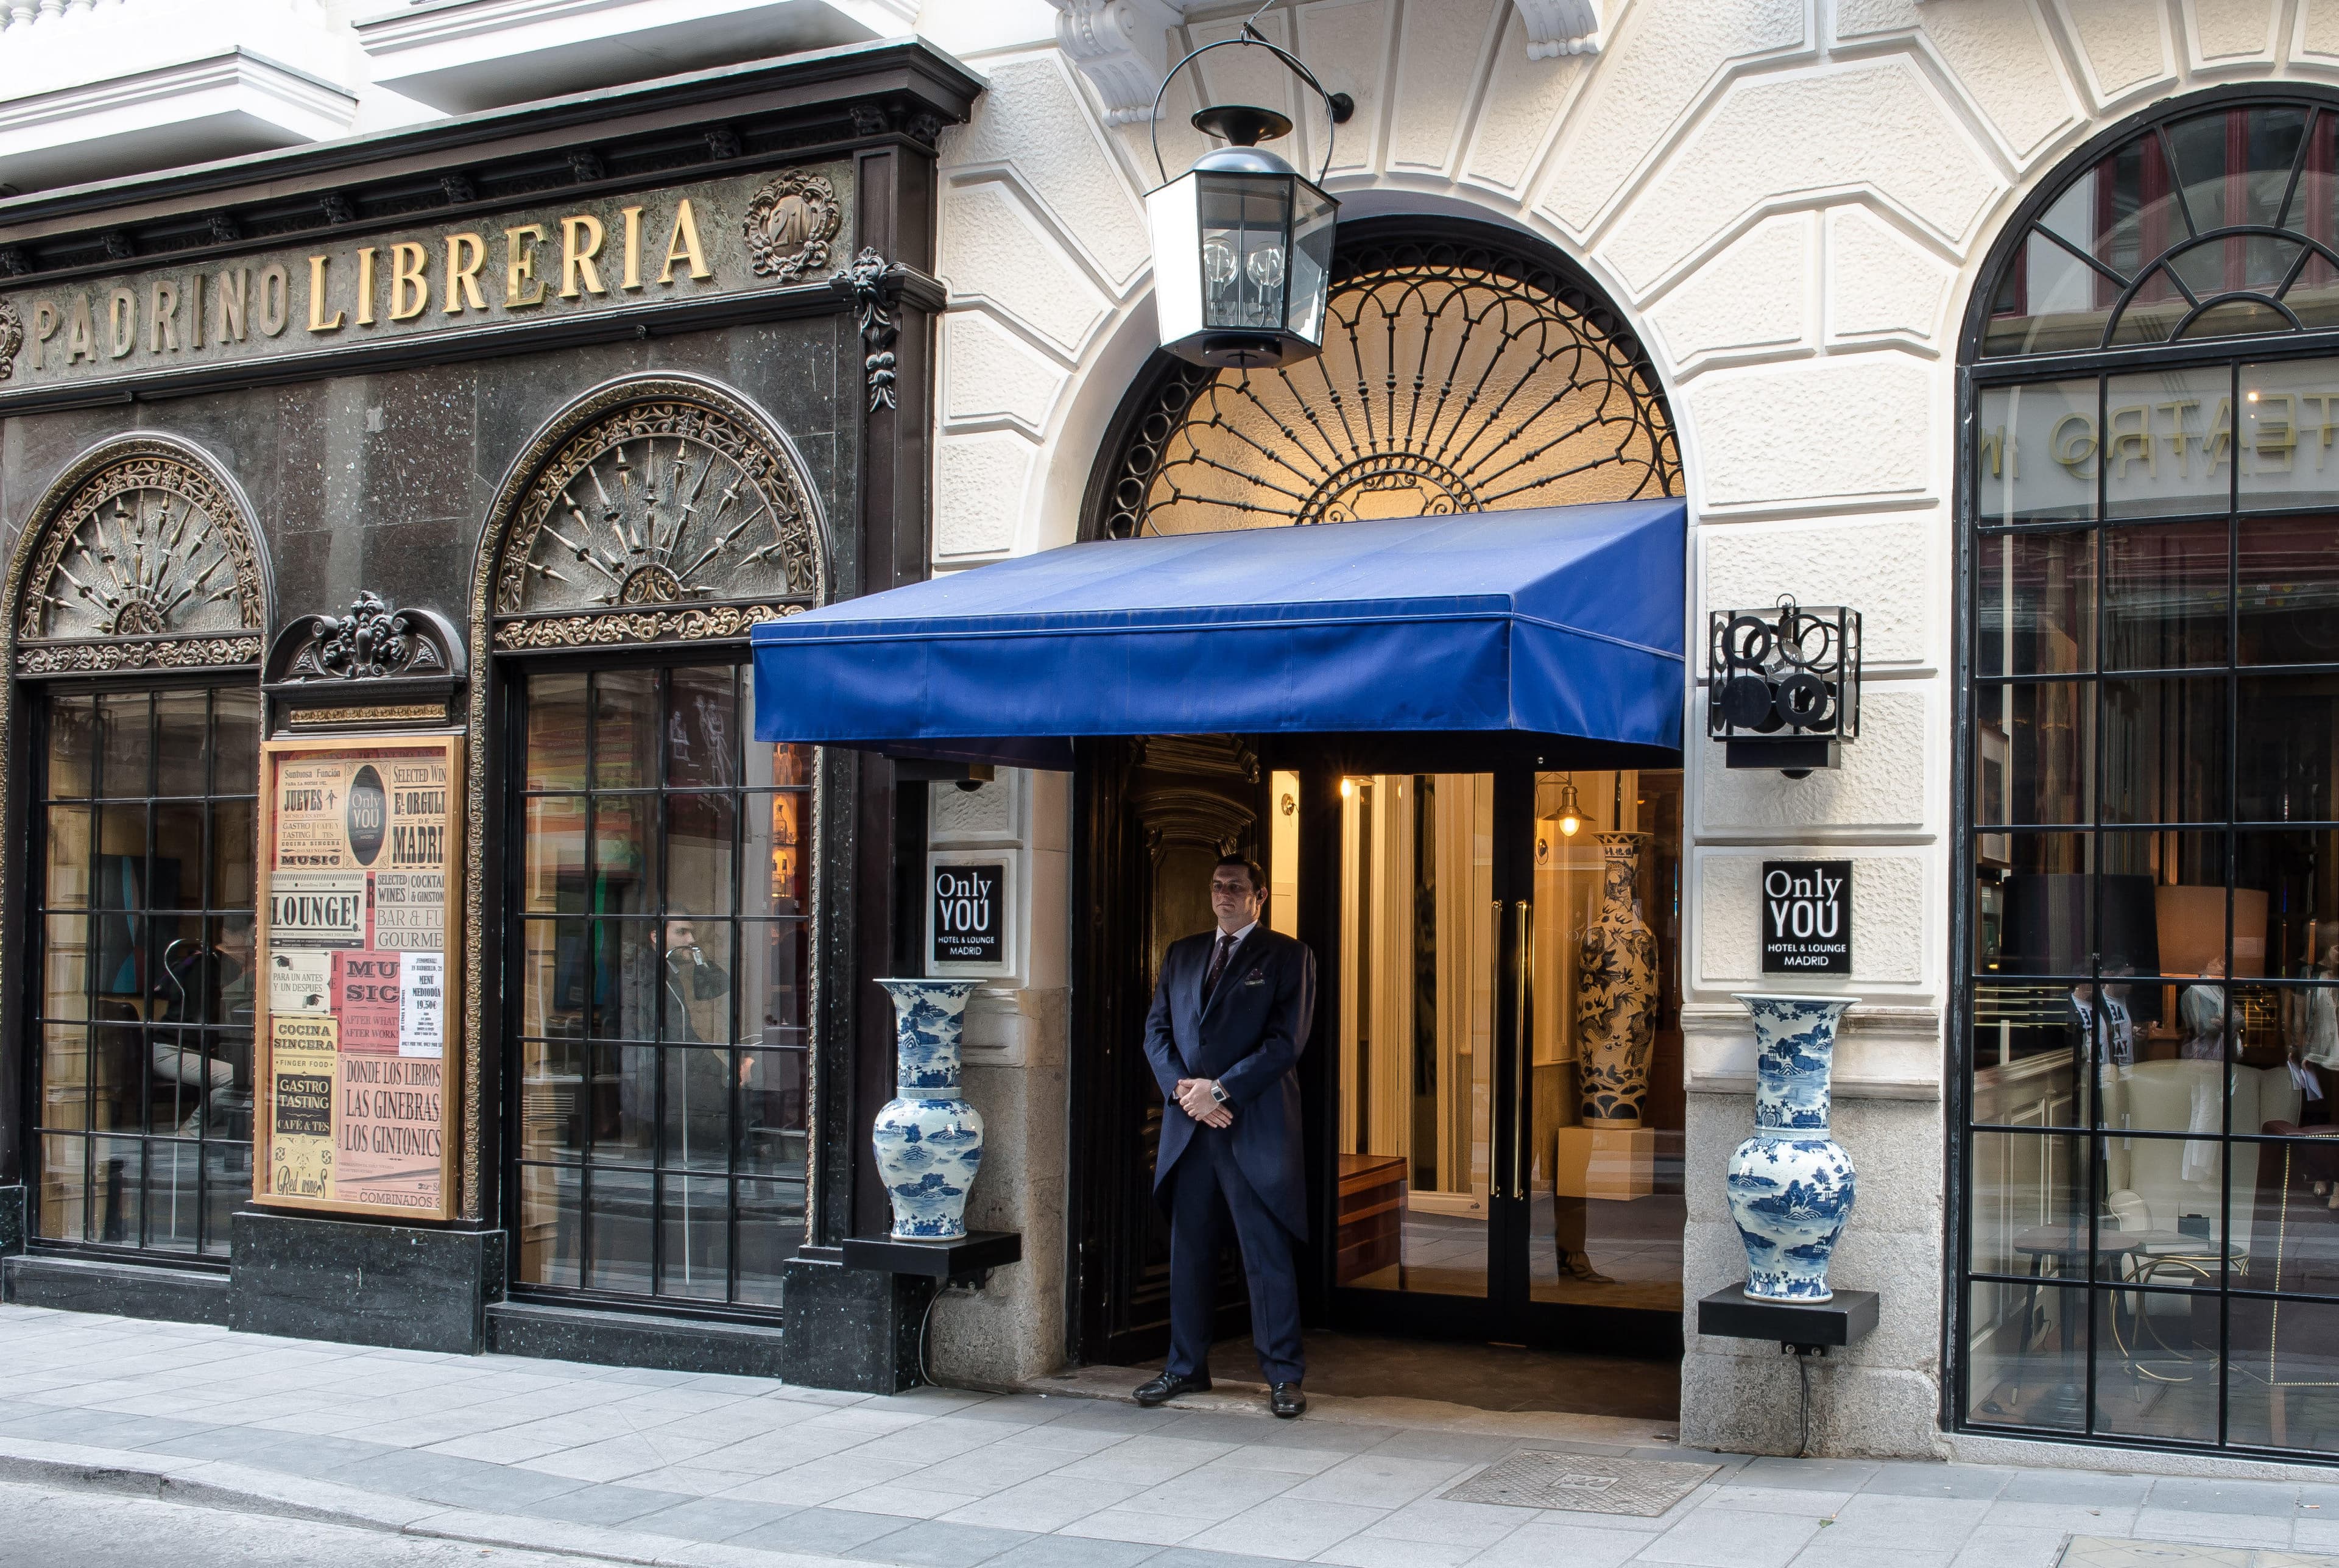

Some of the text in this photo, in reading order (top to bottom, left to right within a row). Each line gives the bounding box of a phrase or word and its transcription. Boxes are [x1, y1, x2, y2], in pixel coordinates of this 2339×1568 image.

[33, 199, 711, 369] PADRINO LIBRERIA
[317, 768, 340, 777] Función
[393, 765, 428, 783] SELECTED
[284, 789, 322, 811] JUEVES
[352, 793, 380, 808] Only
[353, 808, 379, 828] YOU
[393, 826, 443, 863] MADRI
[281, 855, 340, 865] MUSIC
[378, 875, 407, 885] SELECTED
[936, 872, 992, 904] Only
[1765, 868, 1843, 906] Only
[378, 888, 405, 902] WINES
[272, 895, 359, 932] LOUNGE!
[378, 909, 443, 926] BAR & FU
[940, 899, 989, 931] YOU
[1770, 900, 1838, 938] YOU
[379, 932, 443, 947] GOURME
[1784, 956, 1829, 966] MADRID
[347, 961, 400, 978] MU
[419, 974, 434, 984] MENÚ
[292, 983, 322, 992] DESPUES
[347, 985, 400, 1003] SIC
[412, 986, 440, 997] MEDIODÍA
[417, 1000, 437, 1009] 19,50€
[345, 1015, 370, 1025] AFTER
[279, 1025, 331, 1036] COCINA
[274, 1039, 336, 1051] SINCERA
[347, 1061, 441, 1087] DONDE LOS LIBROS
[280, 1079, 329, 1093] GASTRO
[278, 1095, 329, 1109] TASTING
[346, 1089, 439, 1121] LAS GINEBRAS
[278, 1118, 302, 1130] CAFÉ
[312, 1121, 330, 1131] TES
[345, 1125, 440, 1157] LOS GINTONICS
[278, 1165, 298, 1195] Red
[360, 1192, 432, 1208] COMBINADOS
